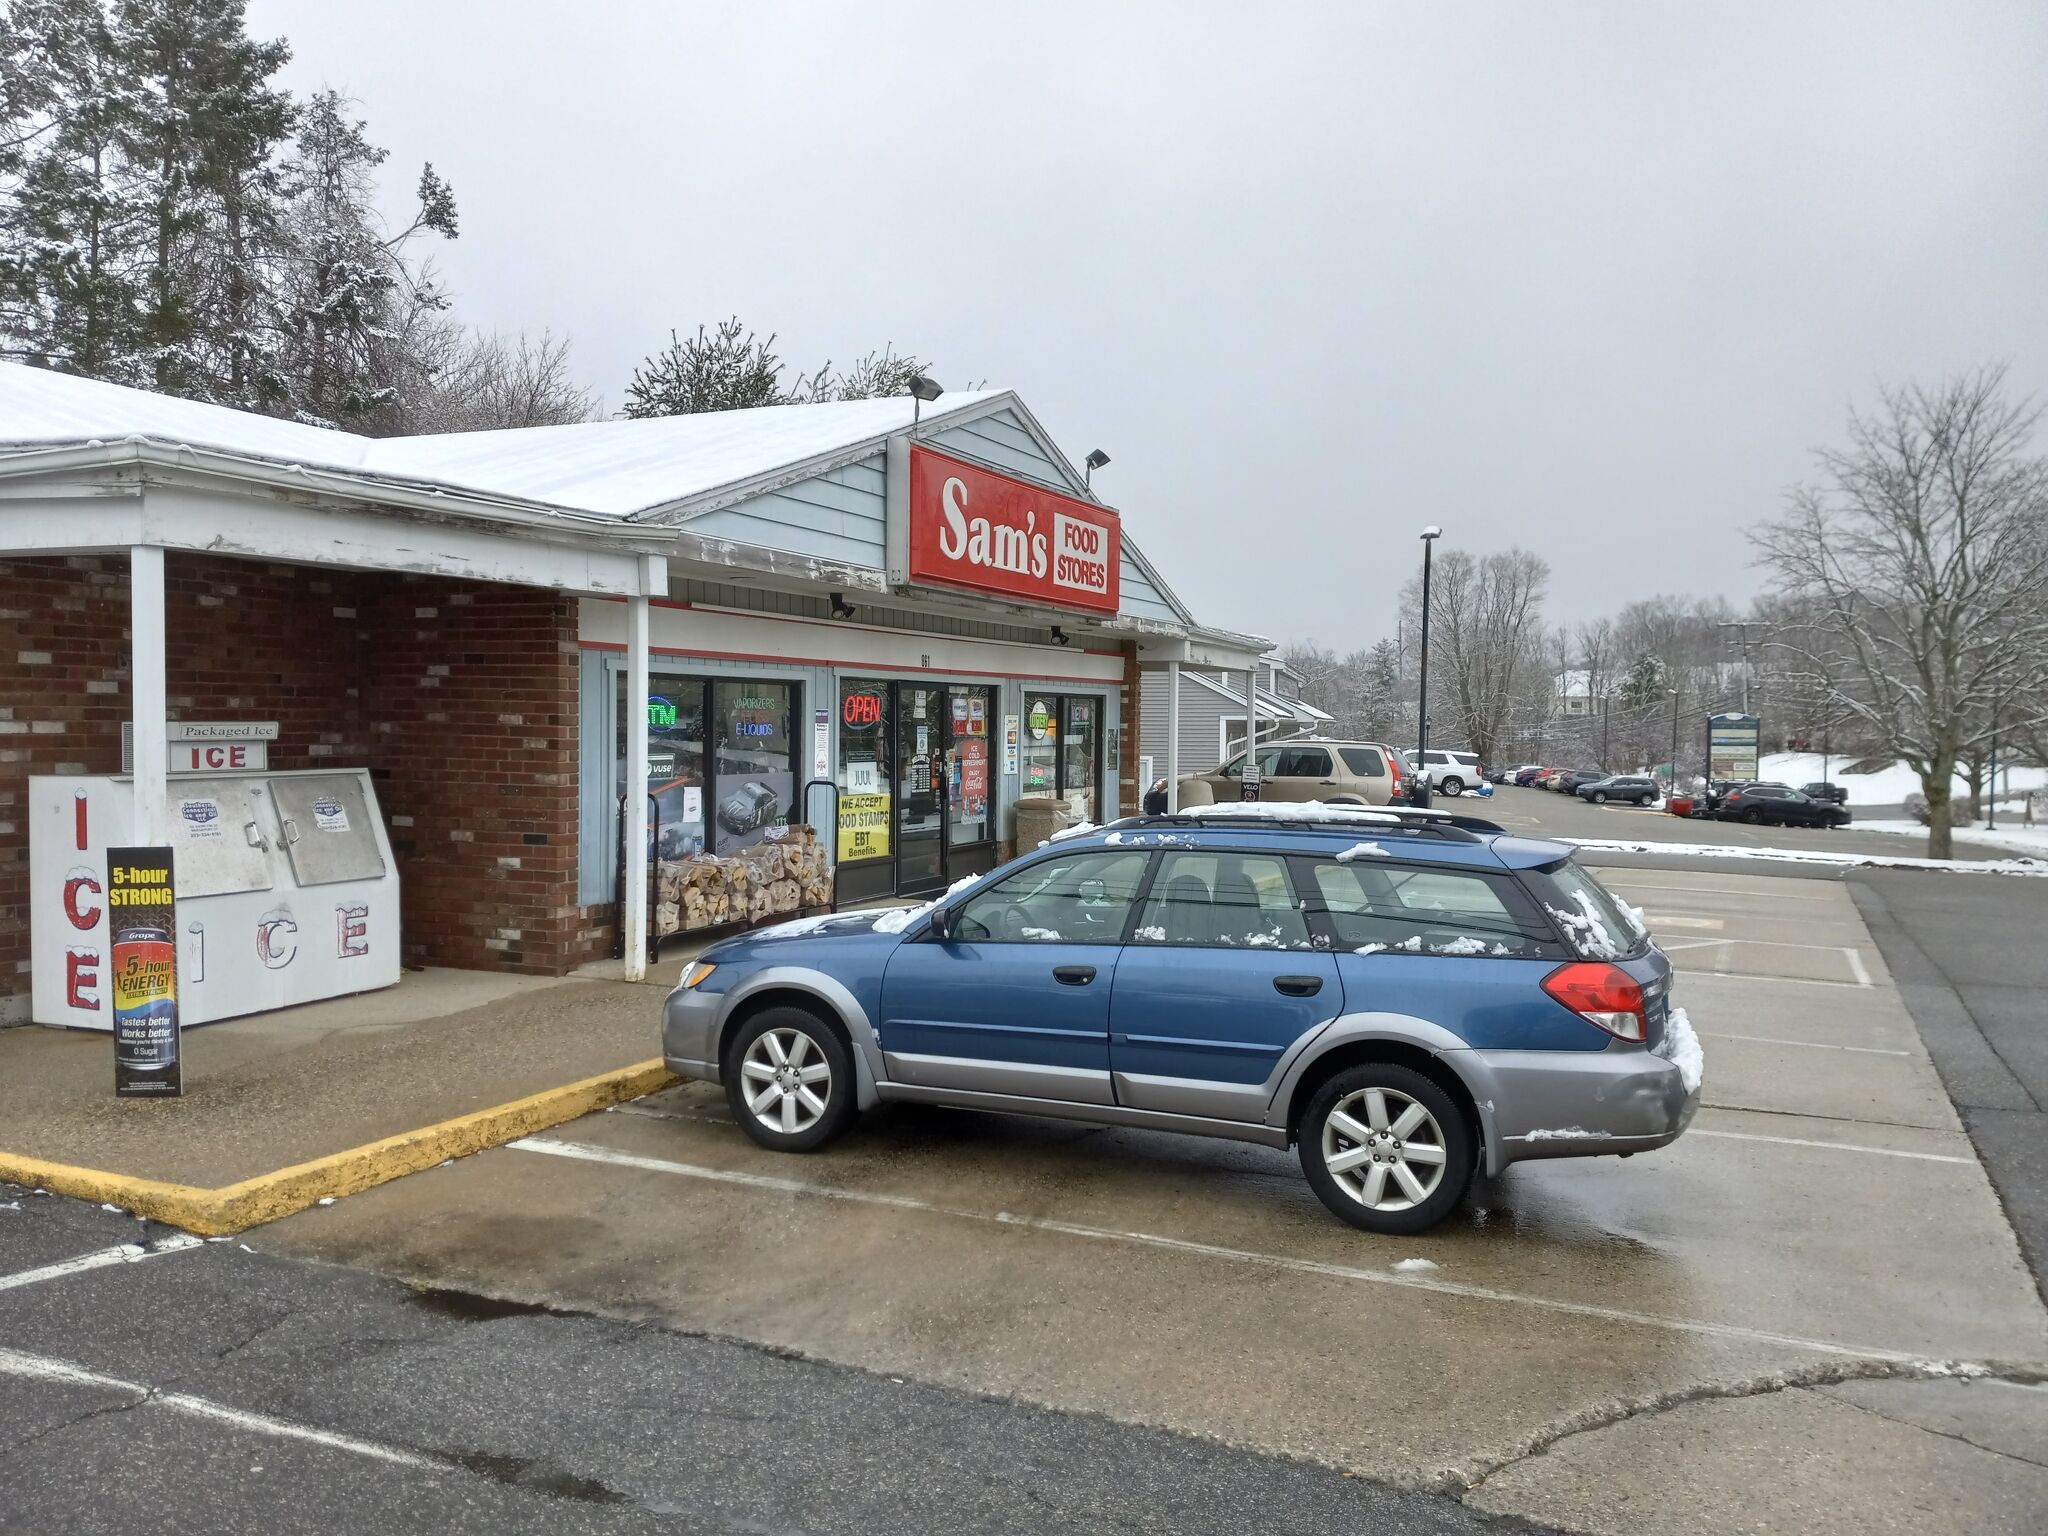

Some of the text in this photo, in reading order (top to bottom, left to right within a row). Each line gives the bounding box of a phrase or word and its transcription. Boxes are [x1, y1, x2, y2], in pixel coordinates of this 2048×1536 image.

[939, 476, 1047, 579] Sam's
[1064, 522, 1099, 554] FOOD
[1057, 554, 1105, 588] STORES
[734, 697, 775, 710] VAPORIZERS
[844, 695, 880, 723] OPEN
[648, 705, 676, 725] TM
[185, 726, 273, 737] Packaged Ice
[736, 723, 773, 735] E-LIQUIDS
[191, 745, 246, 769] ICE
[653, 764, 672, 773] vuse
[842, 796, 883, 809] WE ACCEPT
[859, 810, 889, 827] STAMPS
[854, 831, 870, 847] EBT
[848, 846, 877, 857] Benefits
[113, 867, 168, 884] 5-hour
[64, 787, 102, 1010] ICE
[110, 888, 173, 906] STRONG
[128, 932, 156, 940] Grape
[188, 900, 369, 984] ICE
[126, 954, 171, 976] 5-hour
[122, 973, 171, 992] ENERGY
[121, 1016, 170, 1026] Tastes better
[121, 1028, 171, 1038] Works better
[139, 1047, 159, 1056] Sugar
